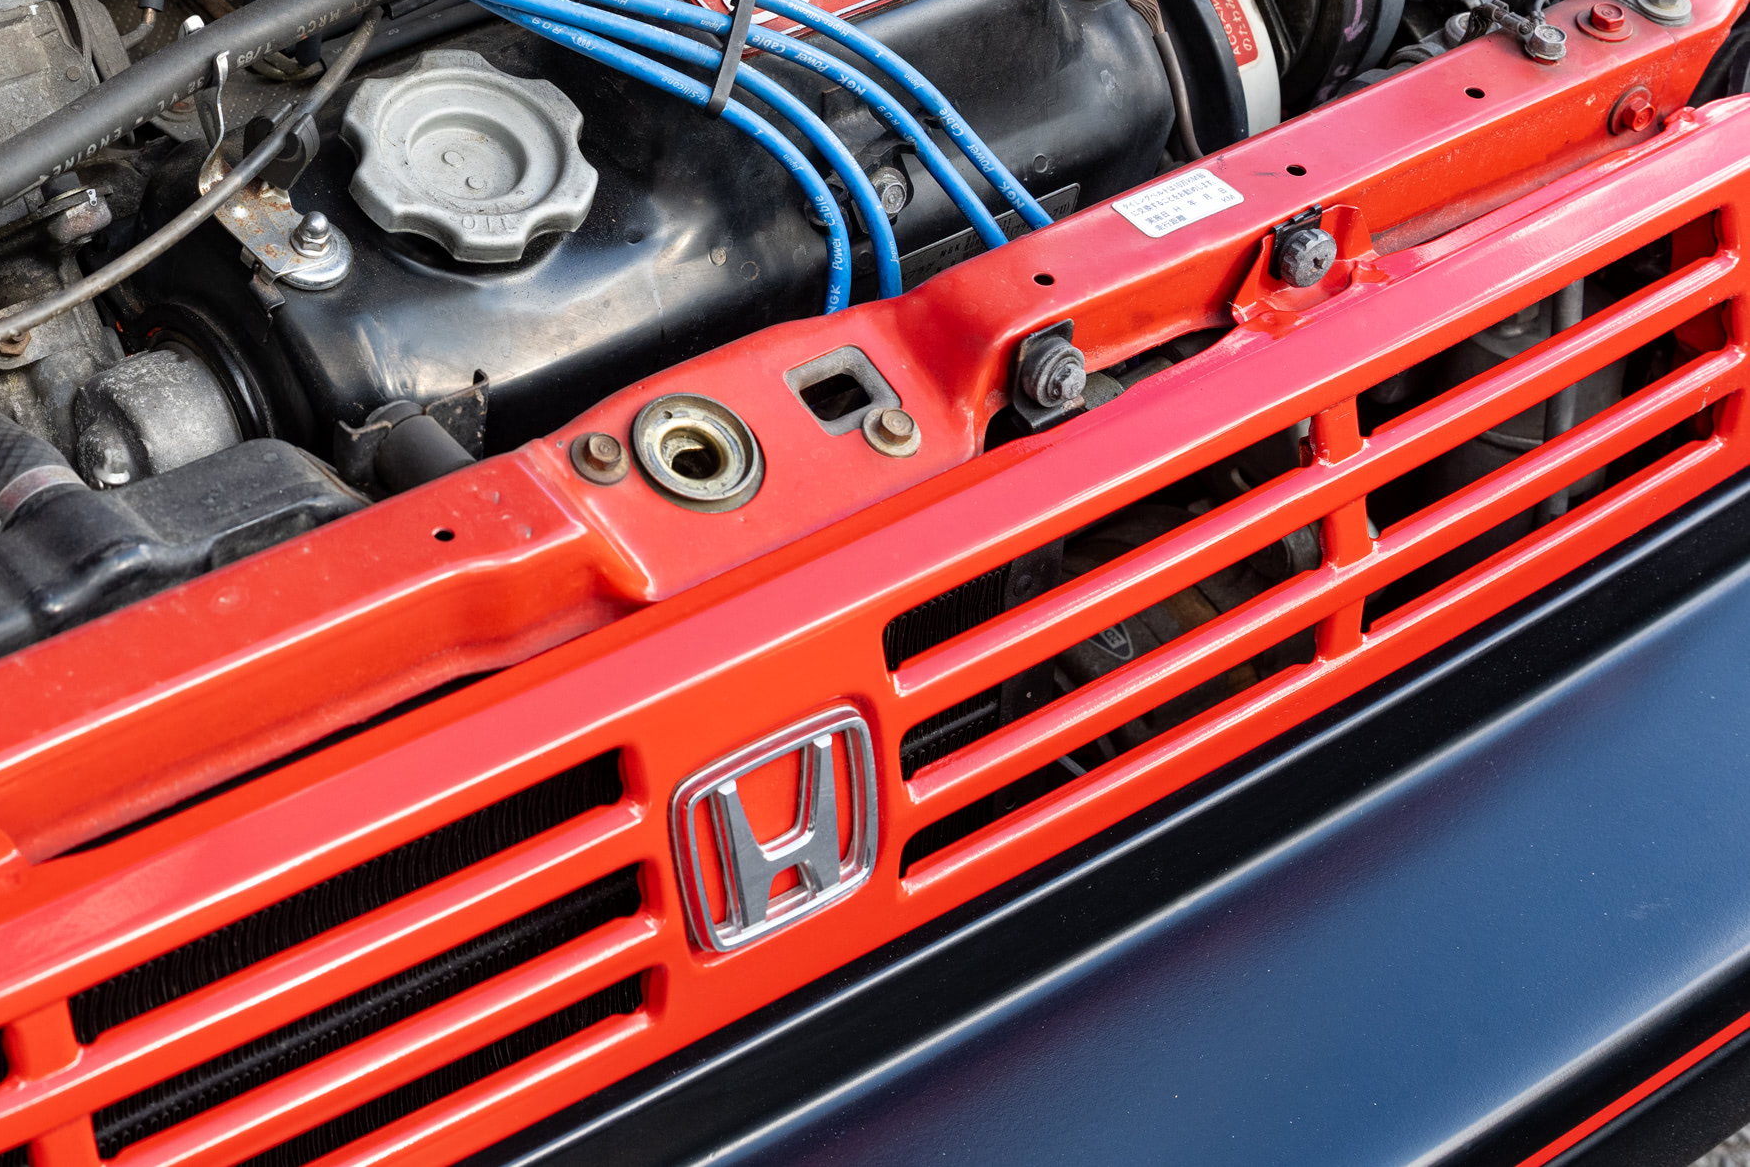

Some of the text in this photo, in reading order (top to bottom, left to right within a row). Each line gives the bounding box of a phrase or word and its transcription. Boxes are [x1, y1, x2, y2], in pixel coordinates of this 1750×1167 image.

[531, 17, 562, 35] R09
[700, 18, 726, 33] Japan
[787, 1, 850, 38] Hyper-Silicone
[750, 34, 787, 54] Cable
[794, 50, 828, 72] Power
[835, 73, 867, 96] NGK
[904, 71, 926, 90] Japan
[939, 107, 965, 137] Cable
[52, 126, 123, 177] ENGINE
[782, 153, 805, 173] Japan
[967, 143, 995, 173] Power
[997, 181, 1026, 211] NGK
[815, 194, 836, 226] Cable
[832, 238, 844, 270] Power
[889, 241, 900, 265] Japan
